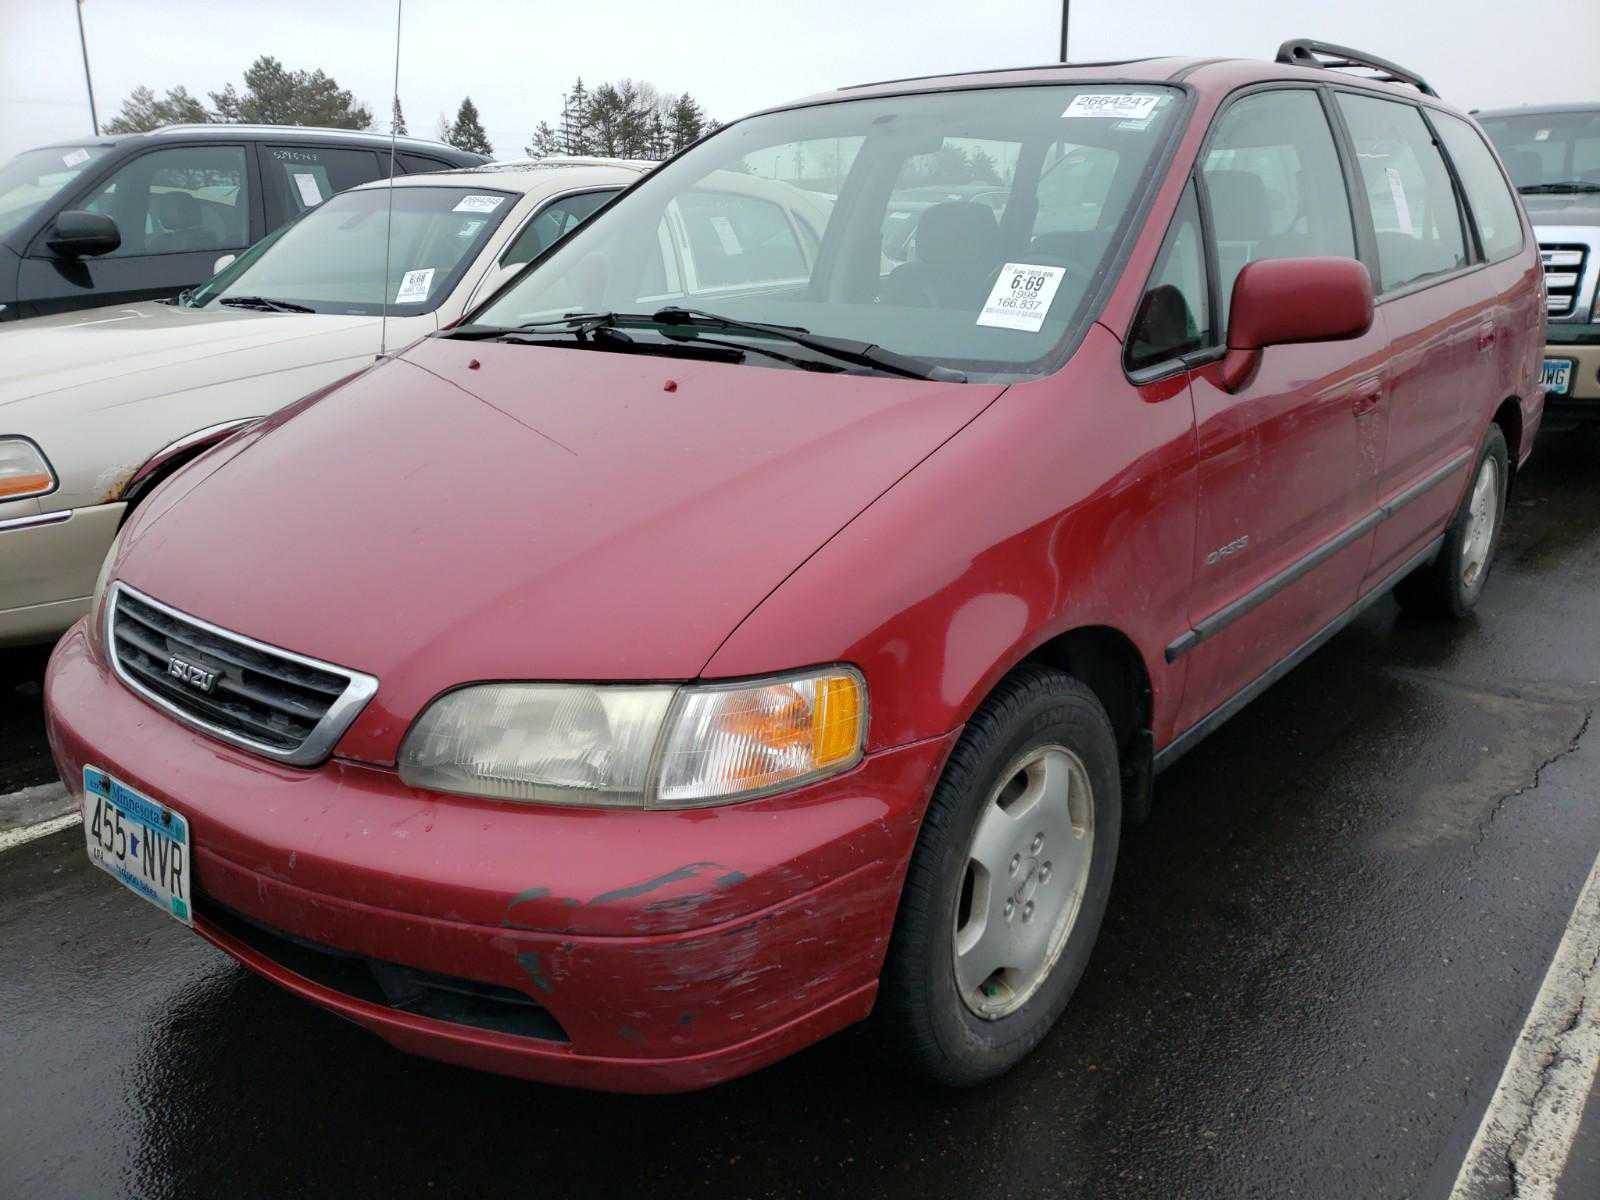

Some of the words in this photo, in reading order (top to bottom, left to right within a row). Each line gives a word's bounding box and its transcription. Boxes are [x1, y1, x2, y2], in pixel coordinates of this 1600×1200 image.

[1075, 96, 1155, 106] 2664247
[1011, 274, 1045, 291] 6:69
[1011, 290, 1038, 299] 1999
[168, 657, 214, 691] ISUZU
[112, 782, 160, 823] Minnesota
[91, 797, 127, 861] 455
[142, 823, 183, 899] NVR
